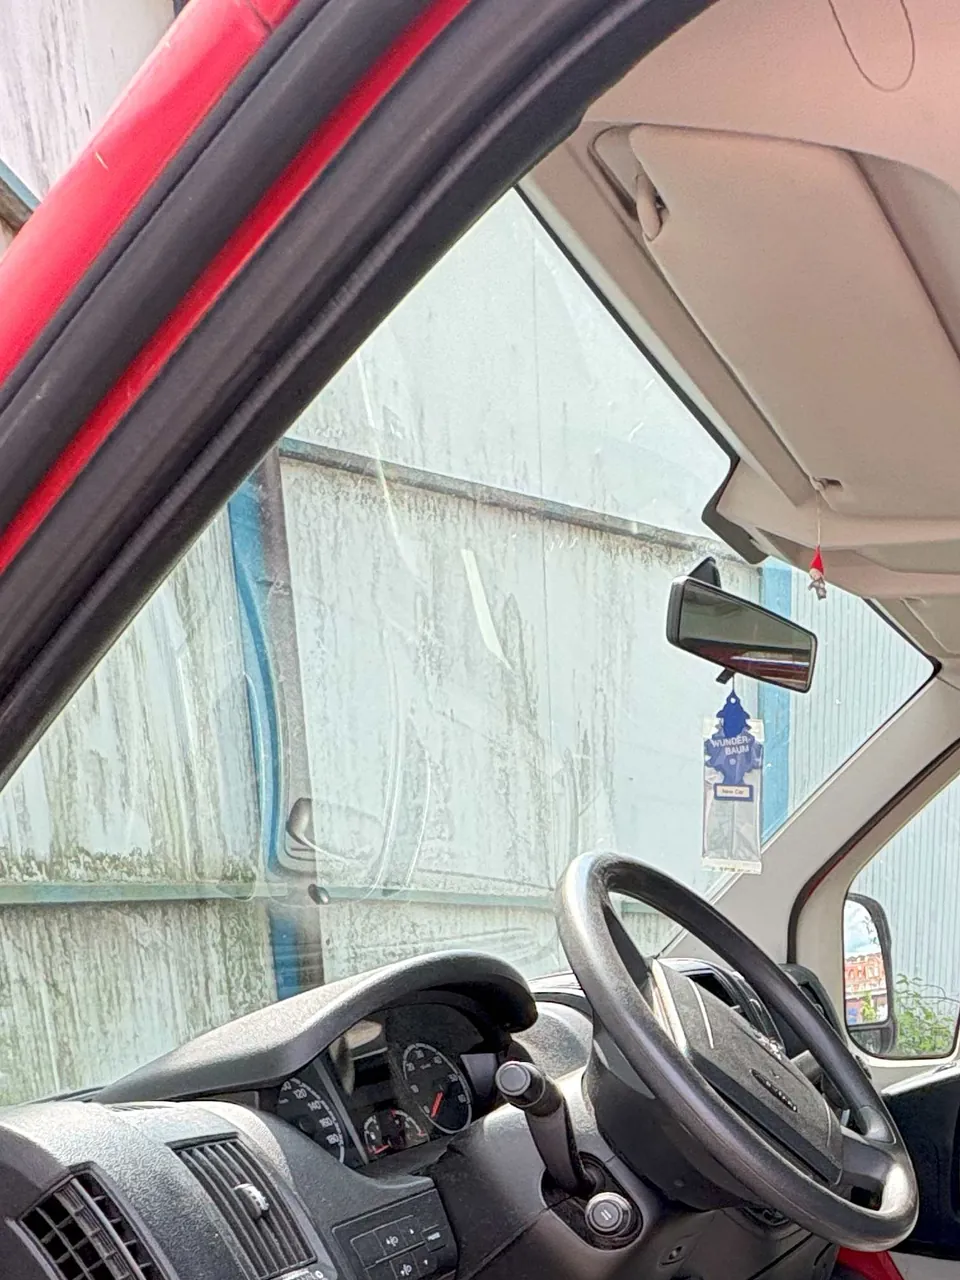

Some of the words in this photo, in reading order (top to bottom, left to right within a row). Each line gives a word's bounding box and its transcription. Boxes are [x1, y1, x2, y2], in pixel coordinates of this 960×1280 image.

[725, 744, 749, 756] BAUM
[293, 1088, 308, 1099] 120
[307, 1100, 322, 1111] 140
